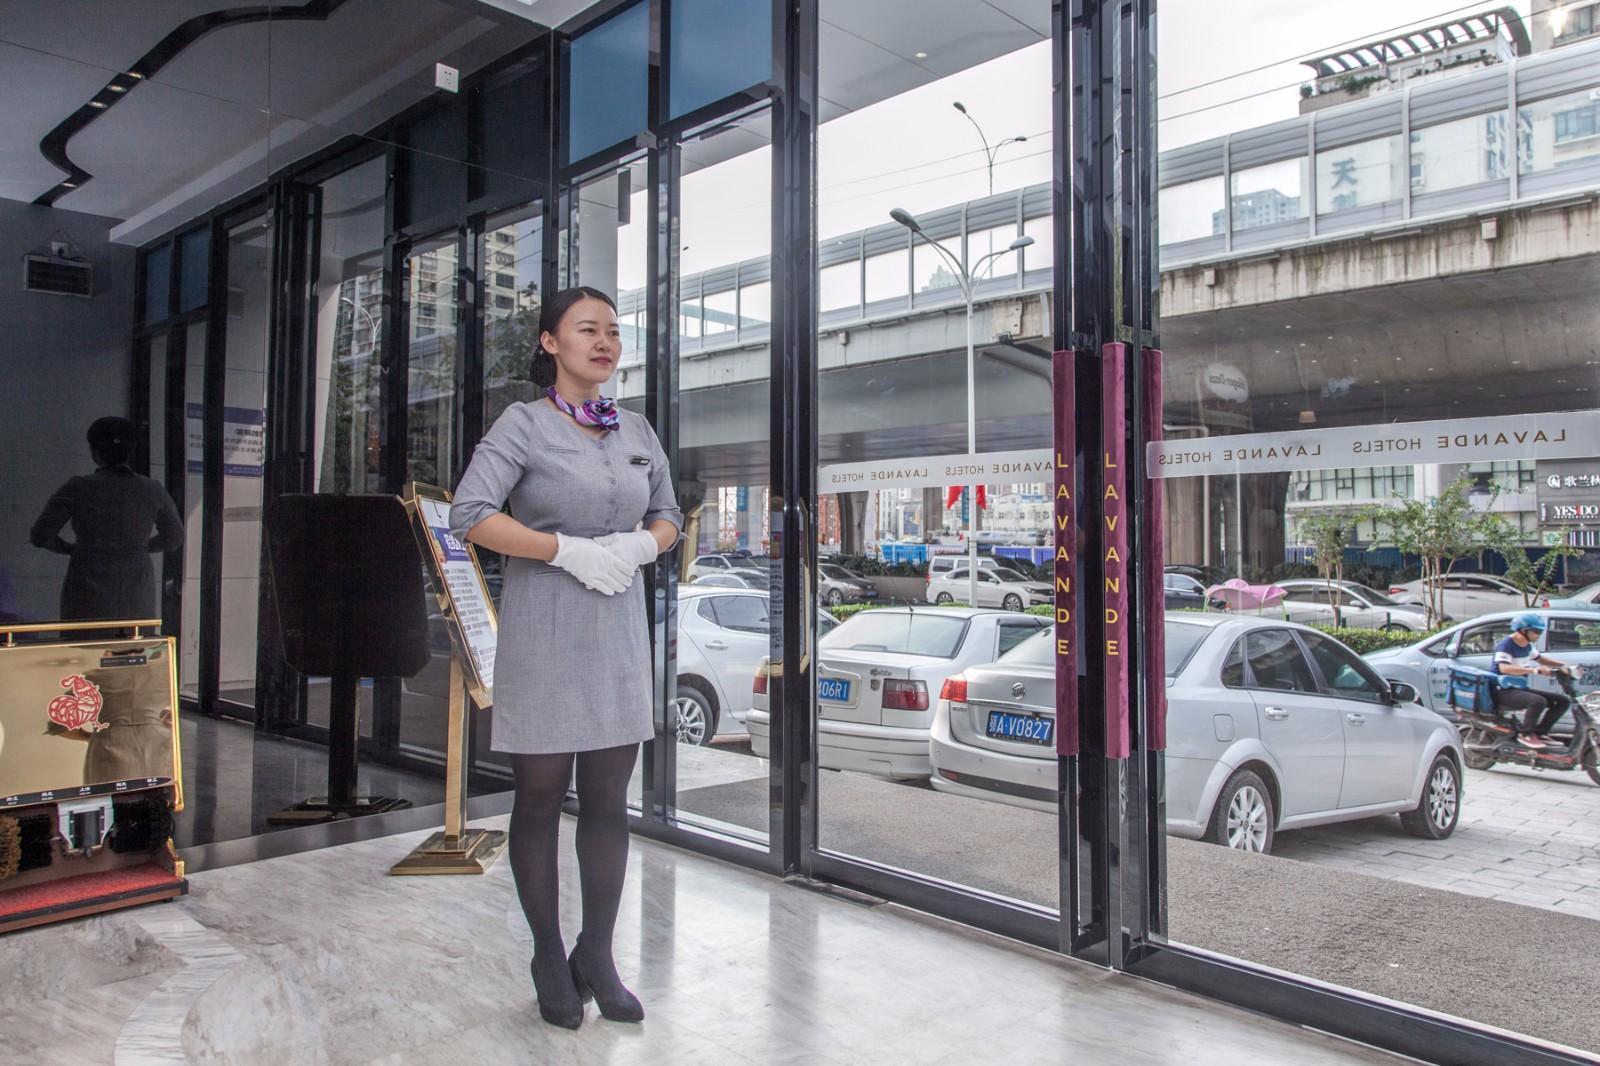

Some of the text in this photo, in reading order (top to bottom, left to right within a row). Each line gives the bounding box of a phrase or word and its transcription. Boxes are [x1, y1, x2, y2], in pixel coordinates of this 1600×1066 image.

[1056, 453, 1070, 656] LAVANDE
[1105, 453, 1121, 657] LAVANDE
[819, 680, 847, 698] 06R1
